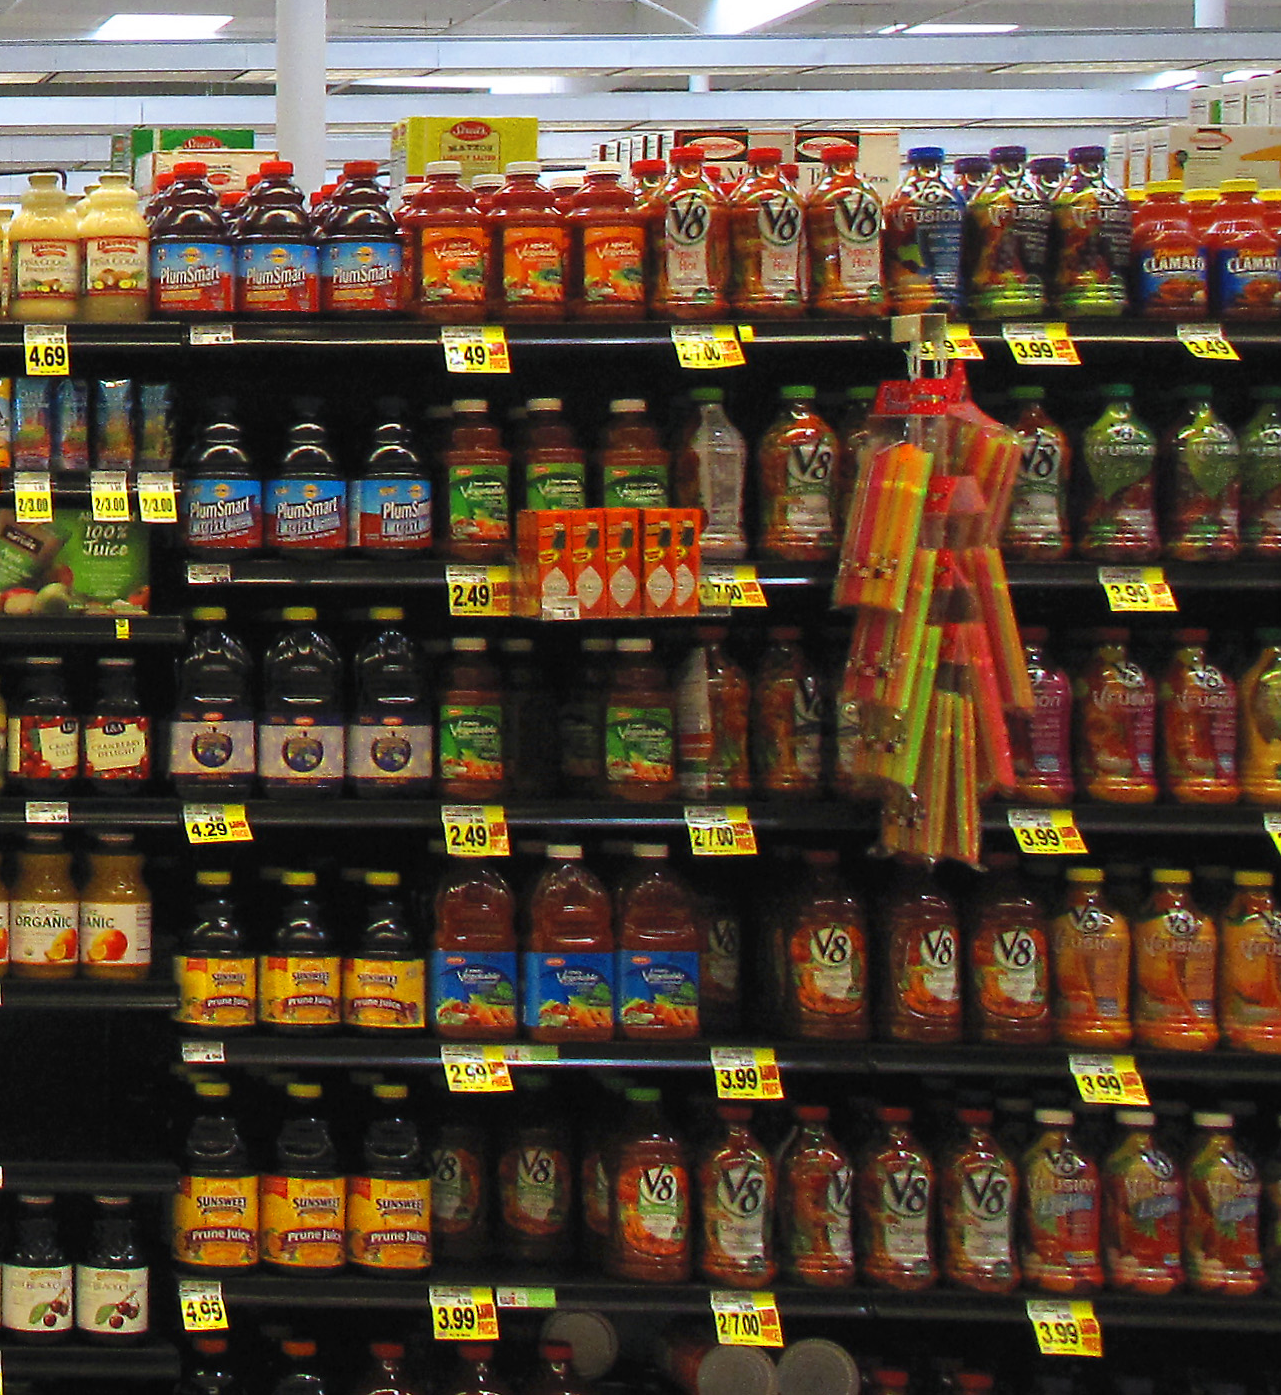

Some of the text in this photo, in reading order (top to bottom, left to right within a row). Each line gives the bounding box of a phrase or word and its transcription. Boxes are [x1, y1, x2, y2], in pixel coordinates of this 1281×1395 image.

[670, 195, 707, 240] V8
[759, 197, 799, 240] V8
[836, 192, 878, 237] V8
[160, 264, 220, 285] PlumSmart
[246, 265, 306, 286] PlumSmart
[332, 264, 393, 285] PlumSmart
[1143, 256, 1205, 274] CLAMATO
[29, 346, 66, 367] 4.69
[1015, 342, 1054, 359] 3.99
[1189, 340, 1231, 356] 3.49
[796, 436, 831, 481] V8
[18, 497, 48, 512] 2/3.00
[94, 498, 126, 512] 2/3.00
[142, 498, 173, 512] 2/3.00
[190, 495, 249, 519] PlumSmart
[276, 495, 338, 519] PlumSmart
[83, 524, 127, 539] 100%
[83, 539, 128, 557] Juice
[452, 584, 489, 606] 2.49
[191, 823, 227, 838] 4.29
[450, 825, 487, 847] 2.49
[1021, 827, 1061, 847] 3.99
[15, 916, 73, 928] ORGANIC
[814, 924, 847, 964] V8
[923, 926, 953, 965] V8
[998, 929, 1032, 966] V8
[207, 997, 231, 1007] Prune
[288, 996, 313, 1007] Prune
[353, 998, 378, 1008] Prune
[720, 1068, 758, 1089] 3.99
[1081, 1075, 1122, 1095] 3.99
[641, 1166, 673, 1201] V8
[724, 1166, 763, 1213] V8
[887, 1168, 926, 1212] V8
[966, 1167, 1008, 1215] V8
[192, 1229, 225, 1241] Prune
[287, 1229, 321, 1242] Prune
[370, 1231, 405, 1243] Prune
[186, 1302, 224, 1322] 4.99
[437, 1306, 475, 1329] 3.99
[1039, 1323, 1078, 1345] 3.99
